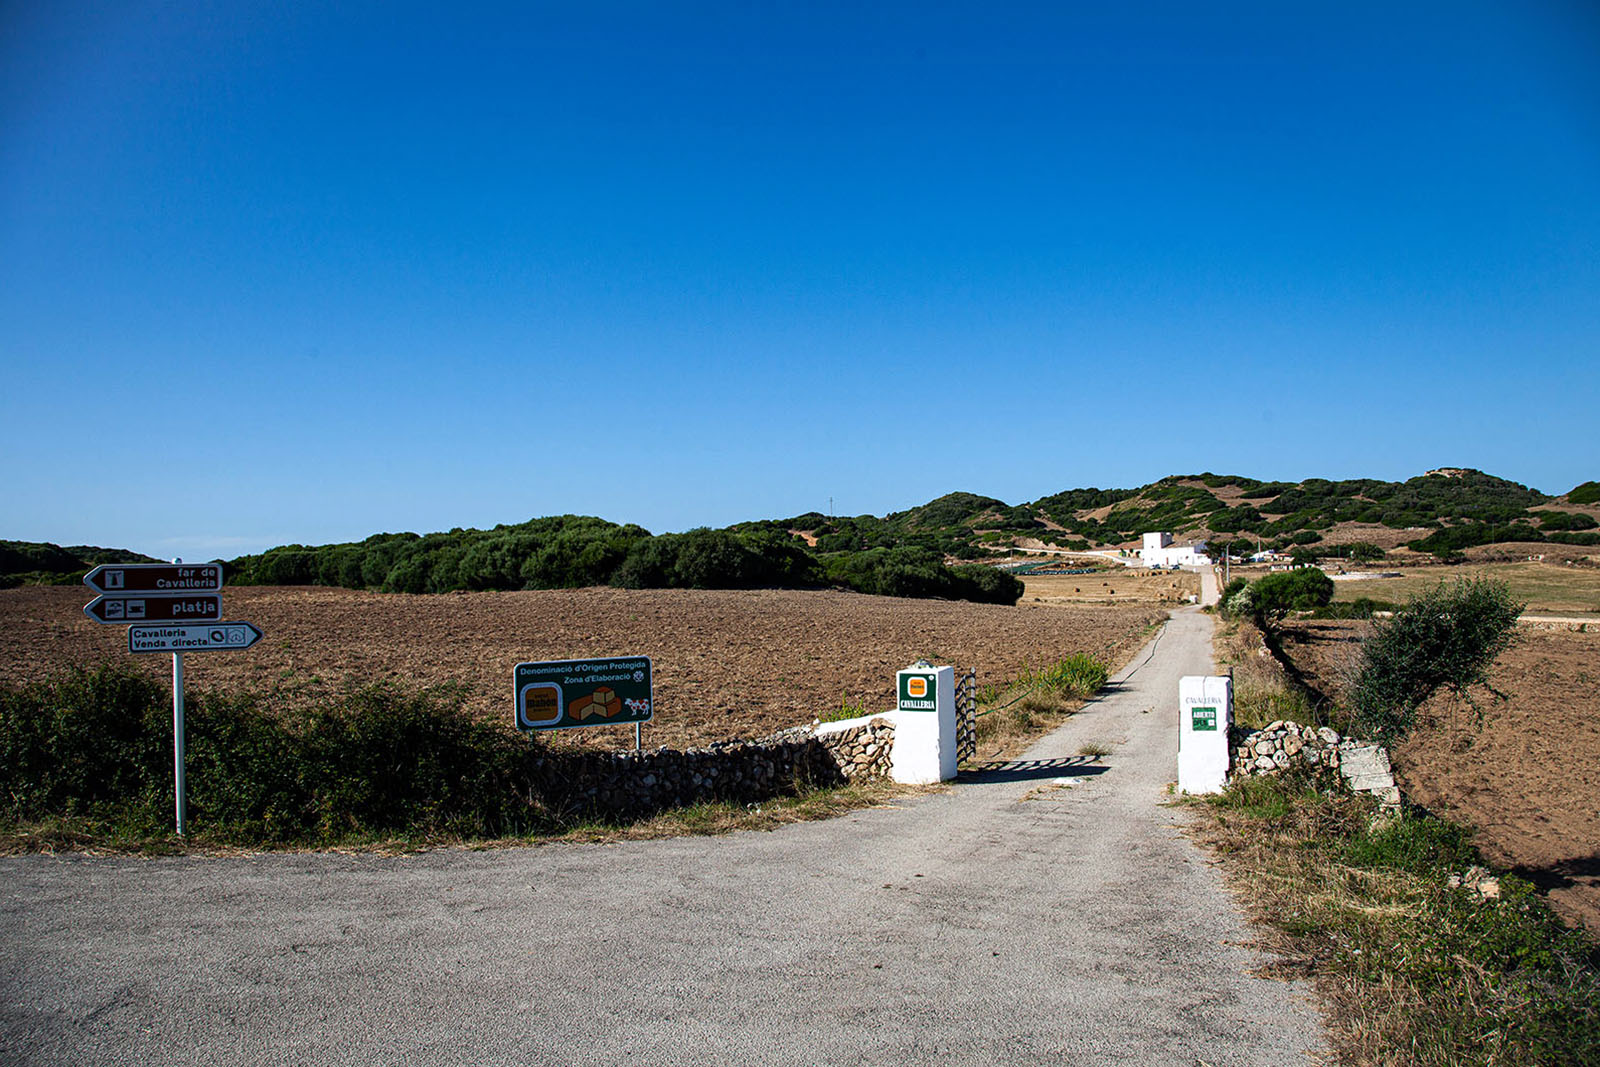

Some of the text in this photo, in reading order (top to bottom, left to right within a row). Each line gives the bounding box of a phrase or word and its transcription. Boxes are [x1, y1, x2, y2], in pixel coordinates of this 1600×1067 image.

[178, 567, 215, 577] far de
[156, 578, 216, 588] Cavalleria
[172, 601, 216, 615] platja
[134, 629, 186, 638] Cavalleria
[134, 638, 208, 648] Venda directa
[520, 661, 646, 675] Denominació d'Origen Protegida
[564, 673, 631, 684] Zona d'Elaboració
